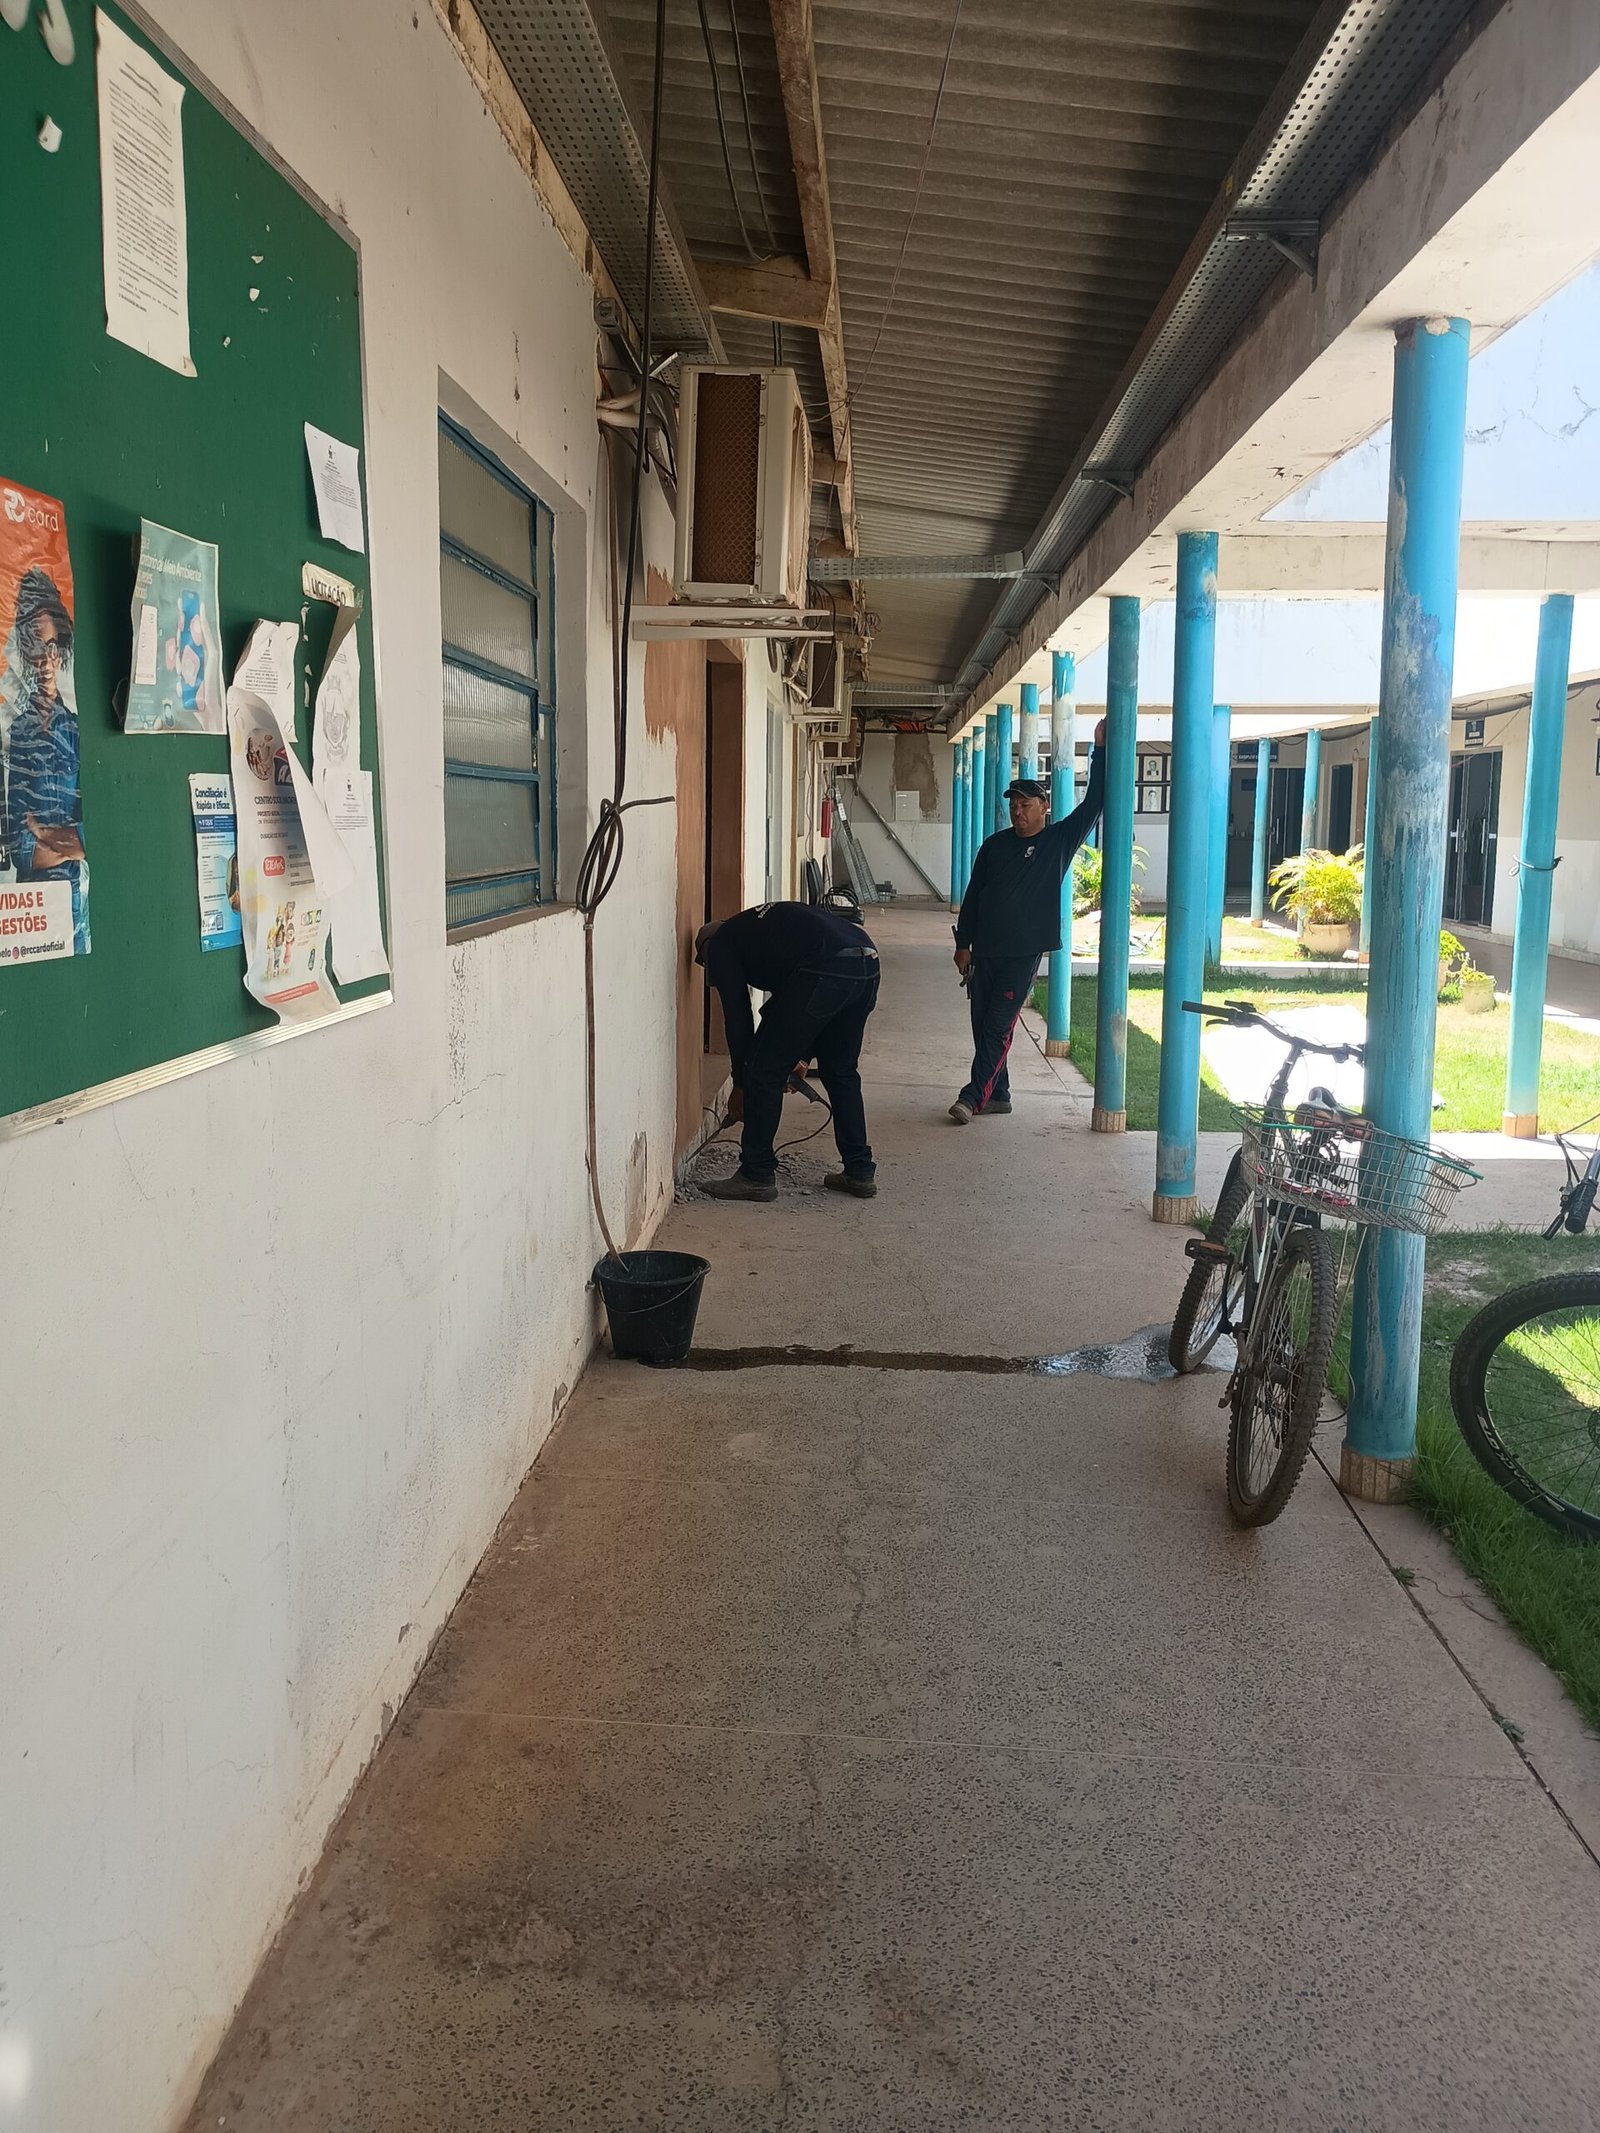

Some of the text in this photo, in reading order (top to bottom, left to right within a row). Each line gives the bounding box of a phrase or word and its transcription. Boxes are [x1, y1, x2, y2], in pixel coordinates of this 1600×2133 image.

[28, 507, 59, 532] card
[176, 561, 202, 582] Ambiente
[195, 787, 223, 800] Conciliação
[216, 800, 231, 810] Eficaz
[36, 891, 44, 907] E
[20, 940, 65, 957] @rccardoficial
